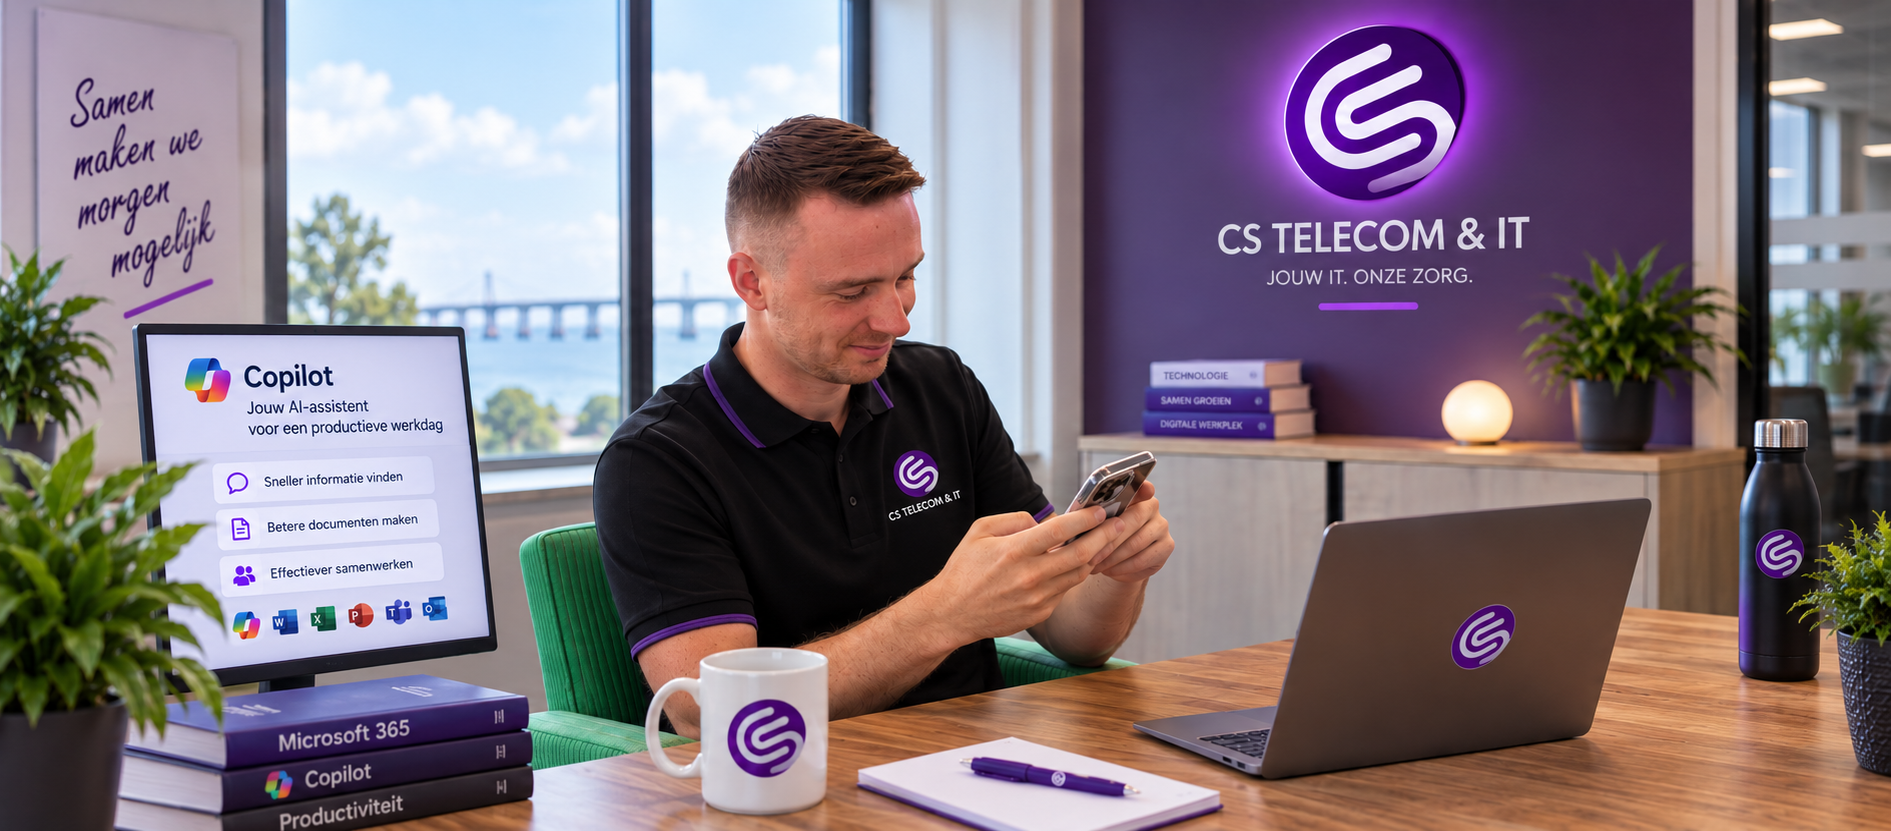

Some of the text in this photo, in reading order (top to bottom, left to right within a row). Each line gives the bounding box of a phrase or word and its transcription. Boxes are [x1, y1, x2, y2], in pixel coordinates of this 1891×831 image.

[70, 77, 154, 128] Samen
[74, 123, 202, 180] maken we
[78, 181, 170, 236] morgen
[111, 200, 215, 287] mogelijk
[1217, 216, 1530, 255] CS TELECOM & IT
[1266, 267, 1473, 286] JOUW IT. ONZE ZORG.
[244, 363, 334, 393] Copilot
[1163, 371, 1229, 380] TECHNOLOGIE
[247, 399, 369, 415] Jouw AI-assistent
[1160, 396, 1232, 406] SAMEN GROEIEN
[248, 418, 444, 437] voor een productieve werkdag
[1160, 420, 1243, 431] DIGITALE WERKPLEK
[264, 471, 404, 488] Sneller informatie vinden
[888, 489, 961, 521] CS TELECOM & IT
[267, 514, 418, 533] Betere documenten maken
[270, 559, 414, 579] Effectiever samenwerken
[279, 719, 410, 752] Microsoft 365
[305, 764, 372, 789] Copilot
[279, 794, 404, 831] Productiviteit
